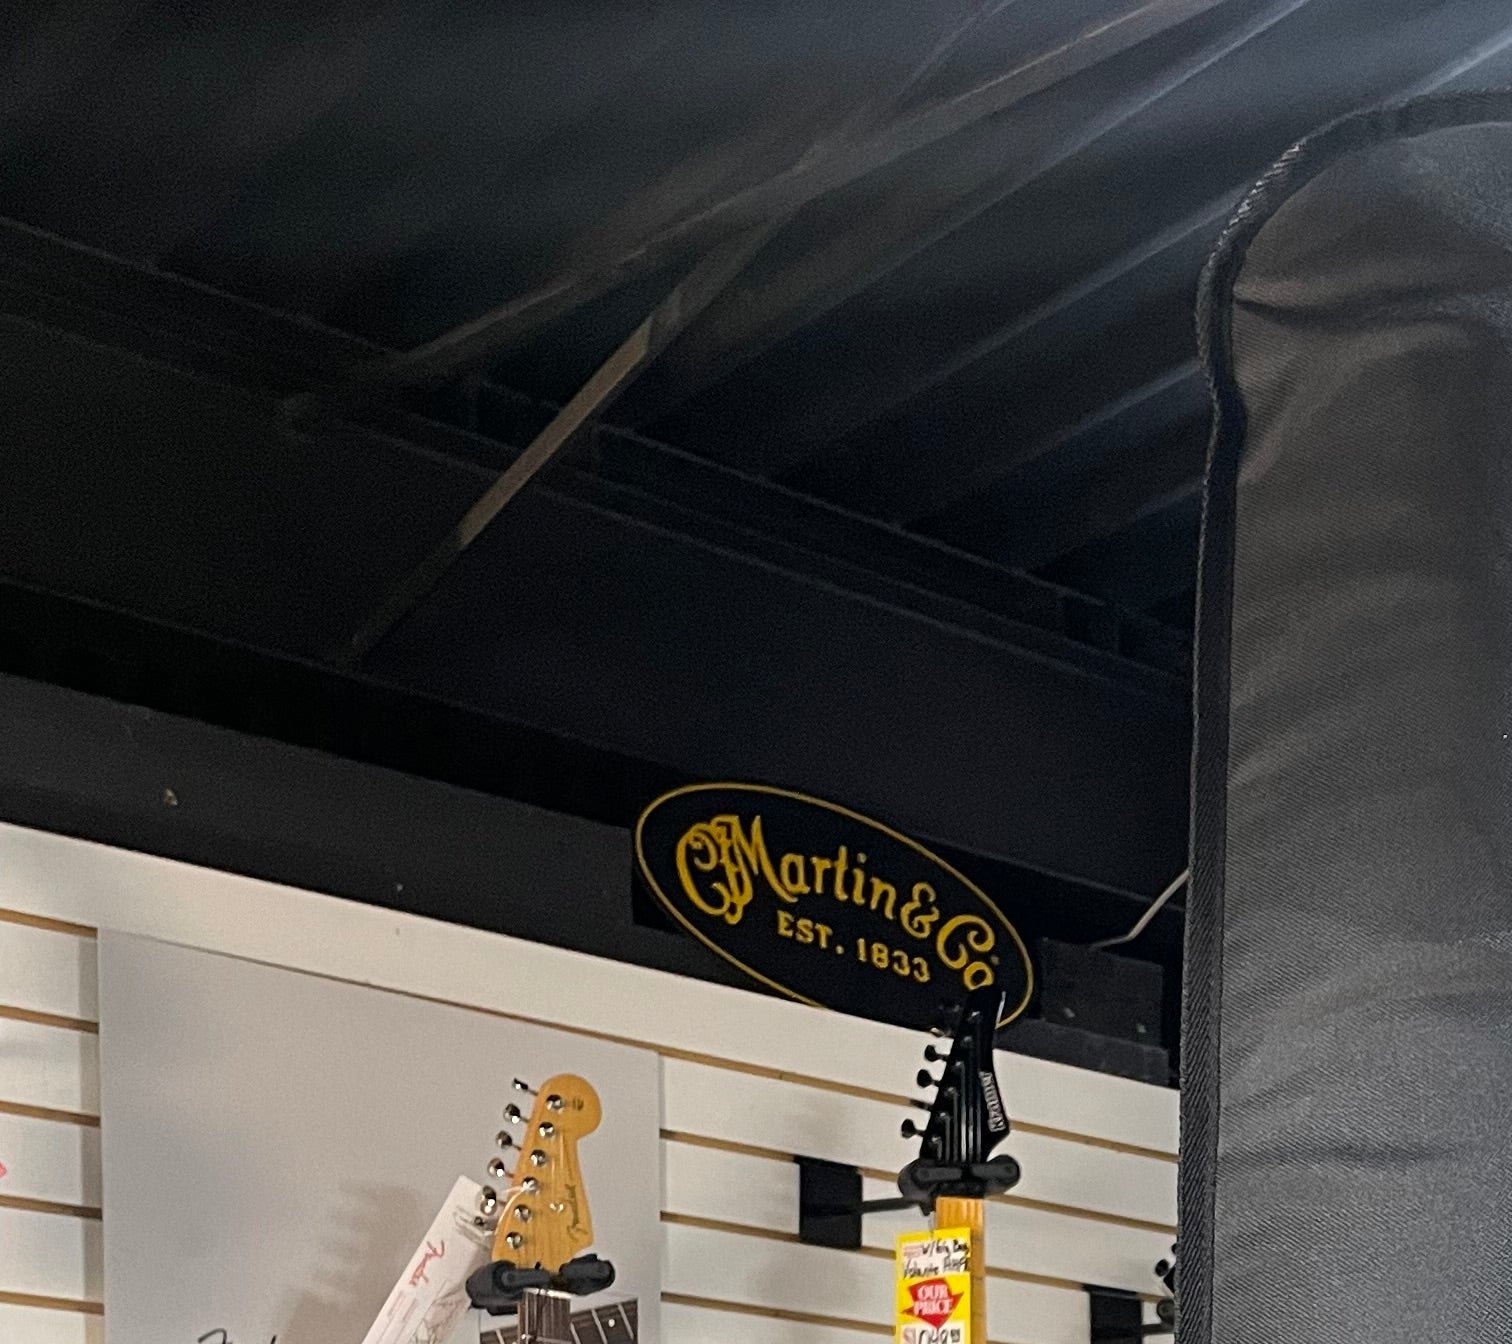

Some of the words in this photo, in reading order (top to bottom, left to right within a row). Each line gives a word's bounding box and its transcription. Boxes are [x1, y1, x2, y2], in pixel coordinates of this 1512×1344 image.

[777, 910, 845, 955] EST.
[856, 937, 931, 983] 1833
[917, 1283, 949, 1300] OUR
[913, 1298, 954, 1316] PRICE
